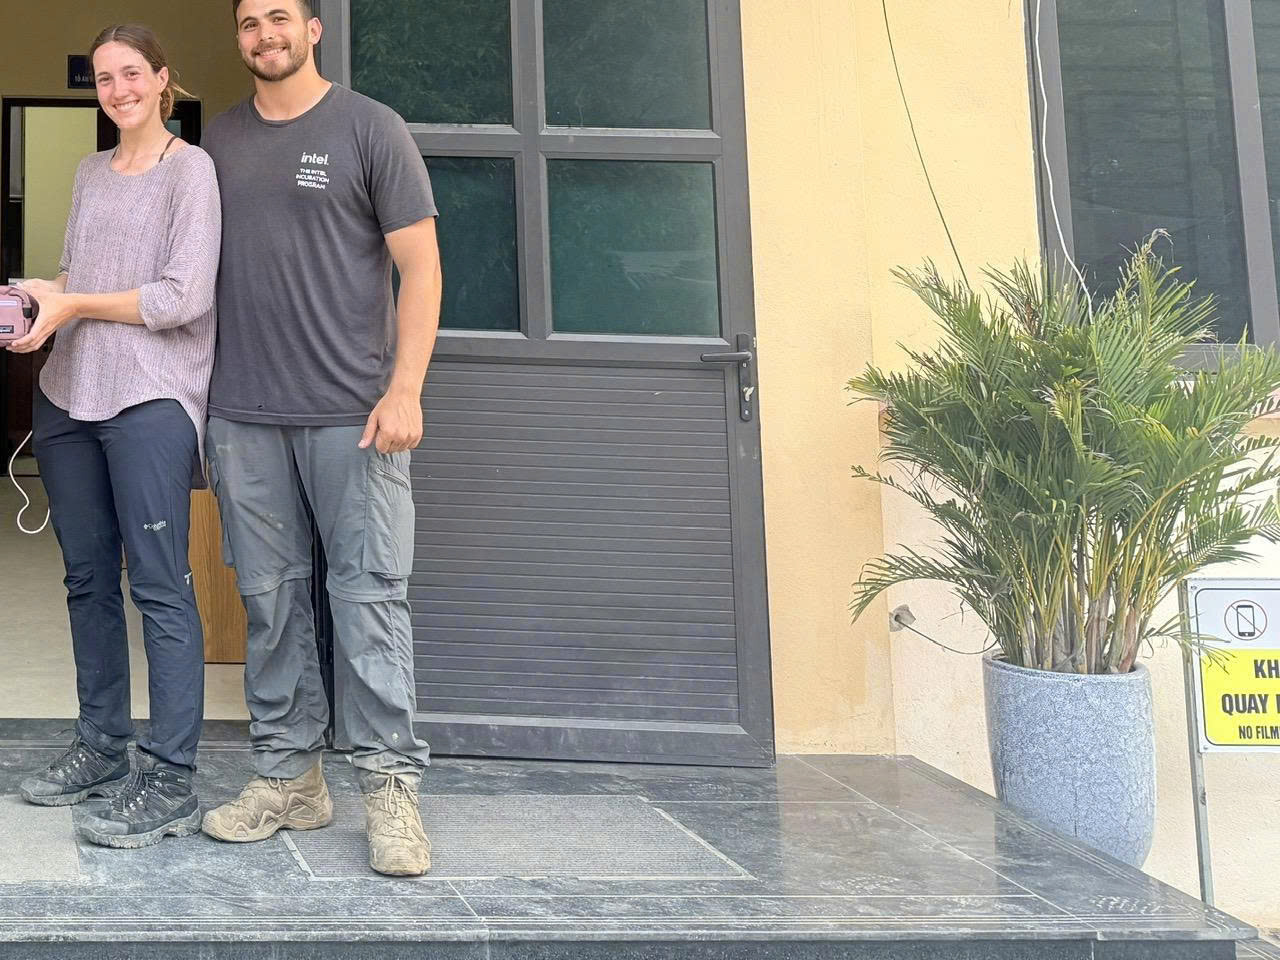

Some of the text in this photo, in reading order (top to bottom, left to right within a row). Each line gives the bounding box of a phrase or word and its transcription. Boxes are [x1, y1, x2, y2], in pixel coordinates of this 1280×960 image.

[296, 174, 330, 183] INCUBATION
[297, 180, 326, 189] PROGRAM
[1221, 693, 1269, 716] QUAY
[1238, 725, 1253, 740] NO
